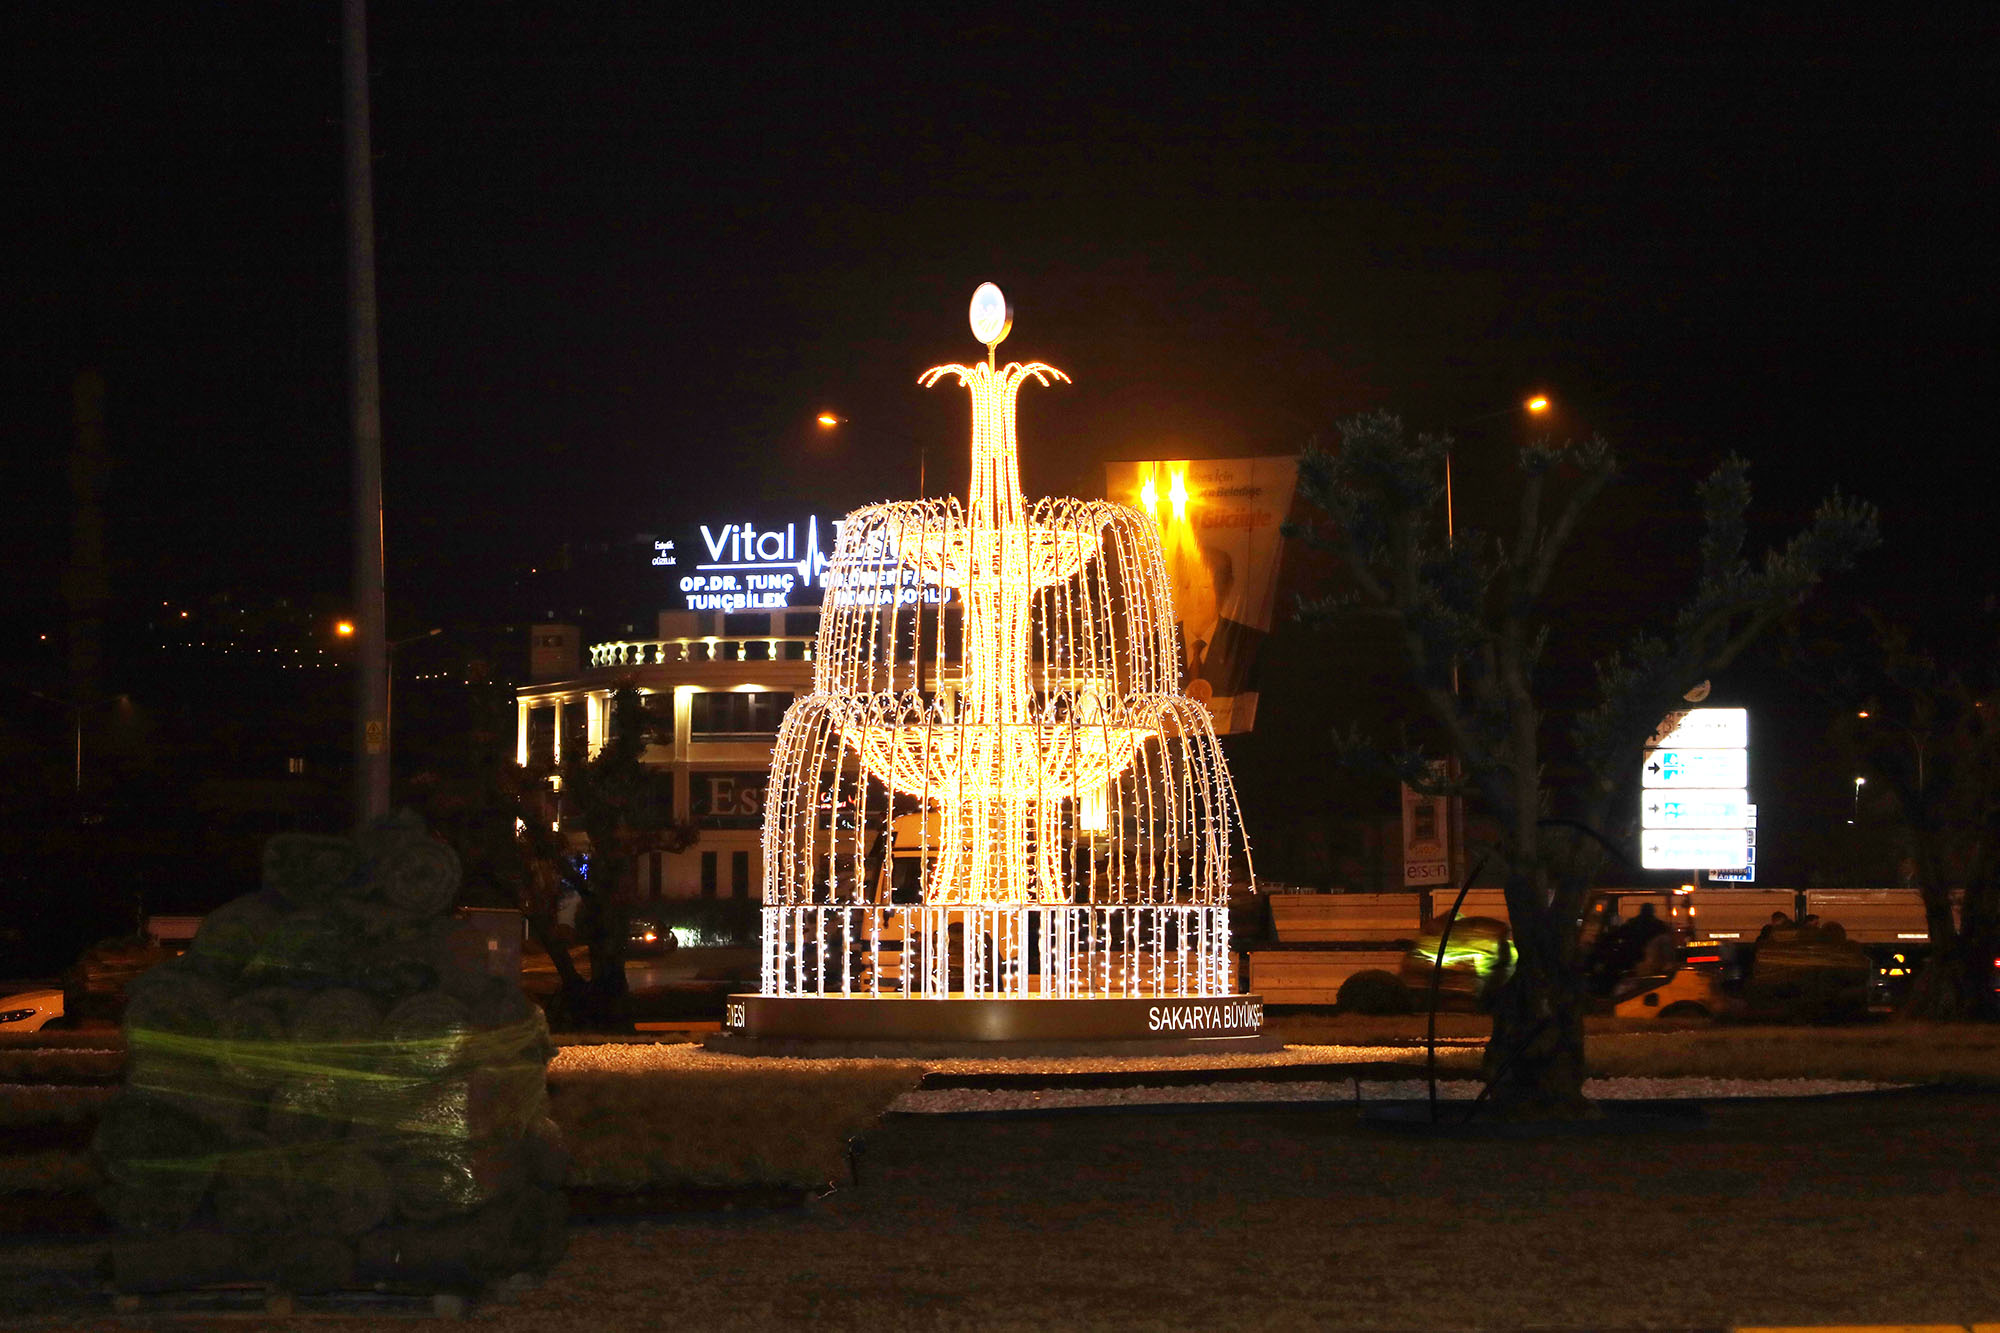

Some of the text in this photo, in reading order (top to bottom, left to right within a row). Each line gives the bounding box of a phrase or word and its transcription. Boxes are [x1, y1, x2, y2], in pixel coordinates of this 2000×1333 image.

[699, 522, 795, 562] Vital
[679, 573, 794, 593] OP.DR. TUNÇ
[685, 590, 789, 614] TUNÇBİLEK
[1148, 1006, 1222, 1031] SAKARYA
